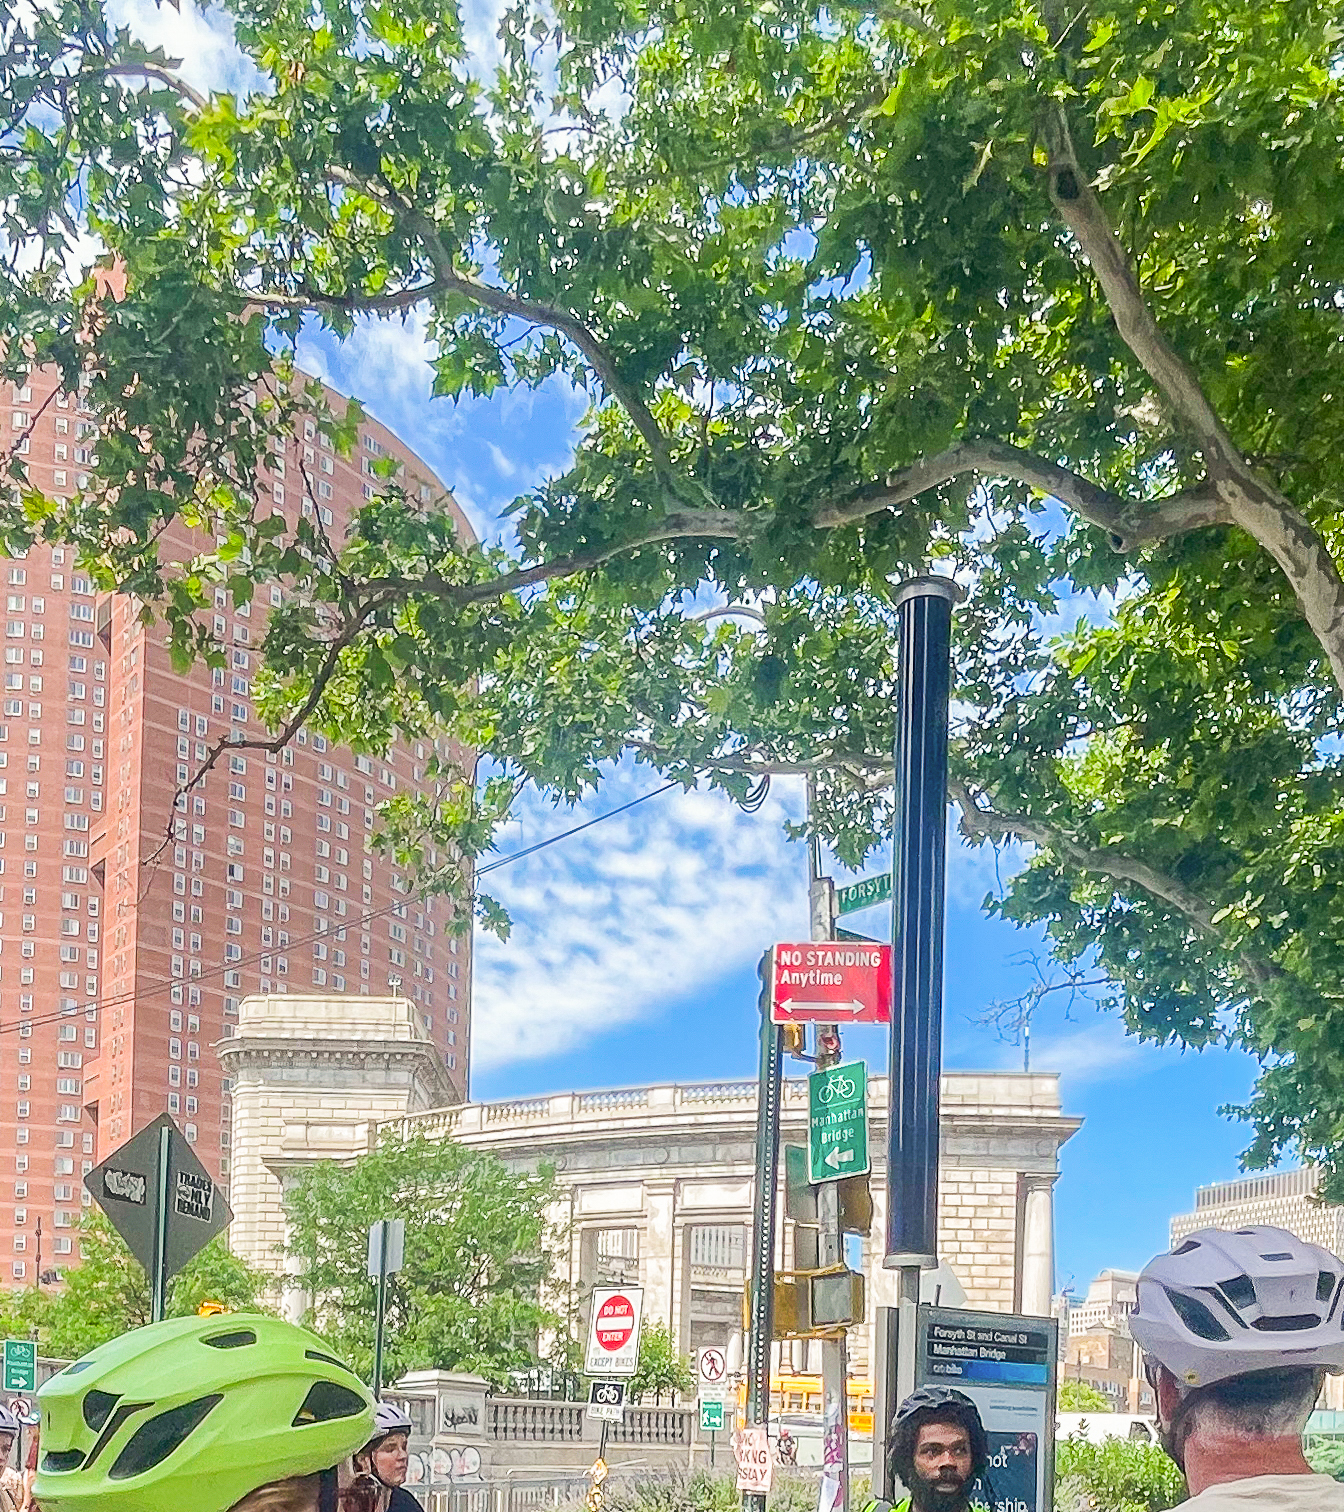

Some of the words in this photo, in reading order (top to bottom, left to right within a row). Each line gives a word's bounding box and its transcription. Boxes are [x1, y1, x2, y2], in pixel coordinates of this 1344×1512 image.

[842, 875, 892, 903] FORSYT
[780, 950, 802, 966] NO
[807, 950, 881, 968] STANDING
[780, 969, 843, 988] Anytime
[811, 1107, 864, 1128] Manhattan
[821, 1127, 855, 1144] Bridge
[603, 1305, 614, 1315] DO
[614, 1304, 629, 1315] NOT
[602, 1332, 624, 1342] ENTER
[933, 1326, 965, 1340] Forsyth
[966, 1329, 976, 1340] St
[994, 1332, 1017, 1343] Canal
[1018, 1334, 1028, 1344] St
[933, 1344, 977, 1357] Manhattan
[979, 1347, 1006, 1360] Bridge
